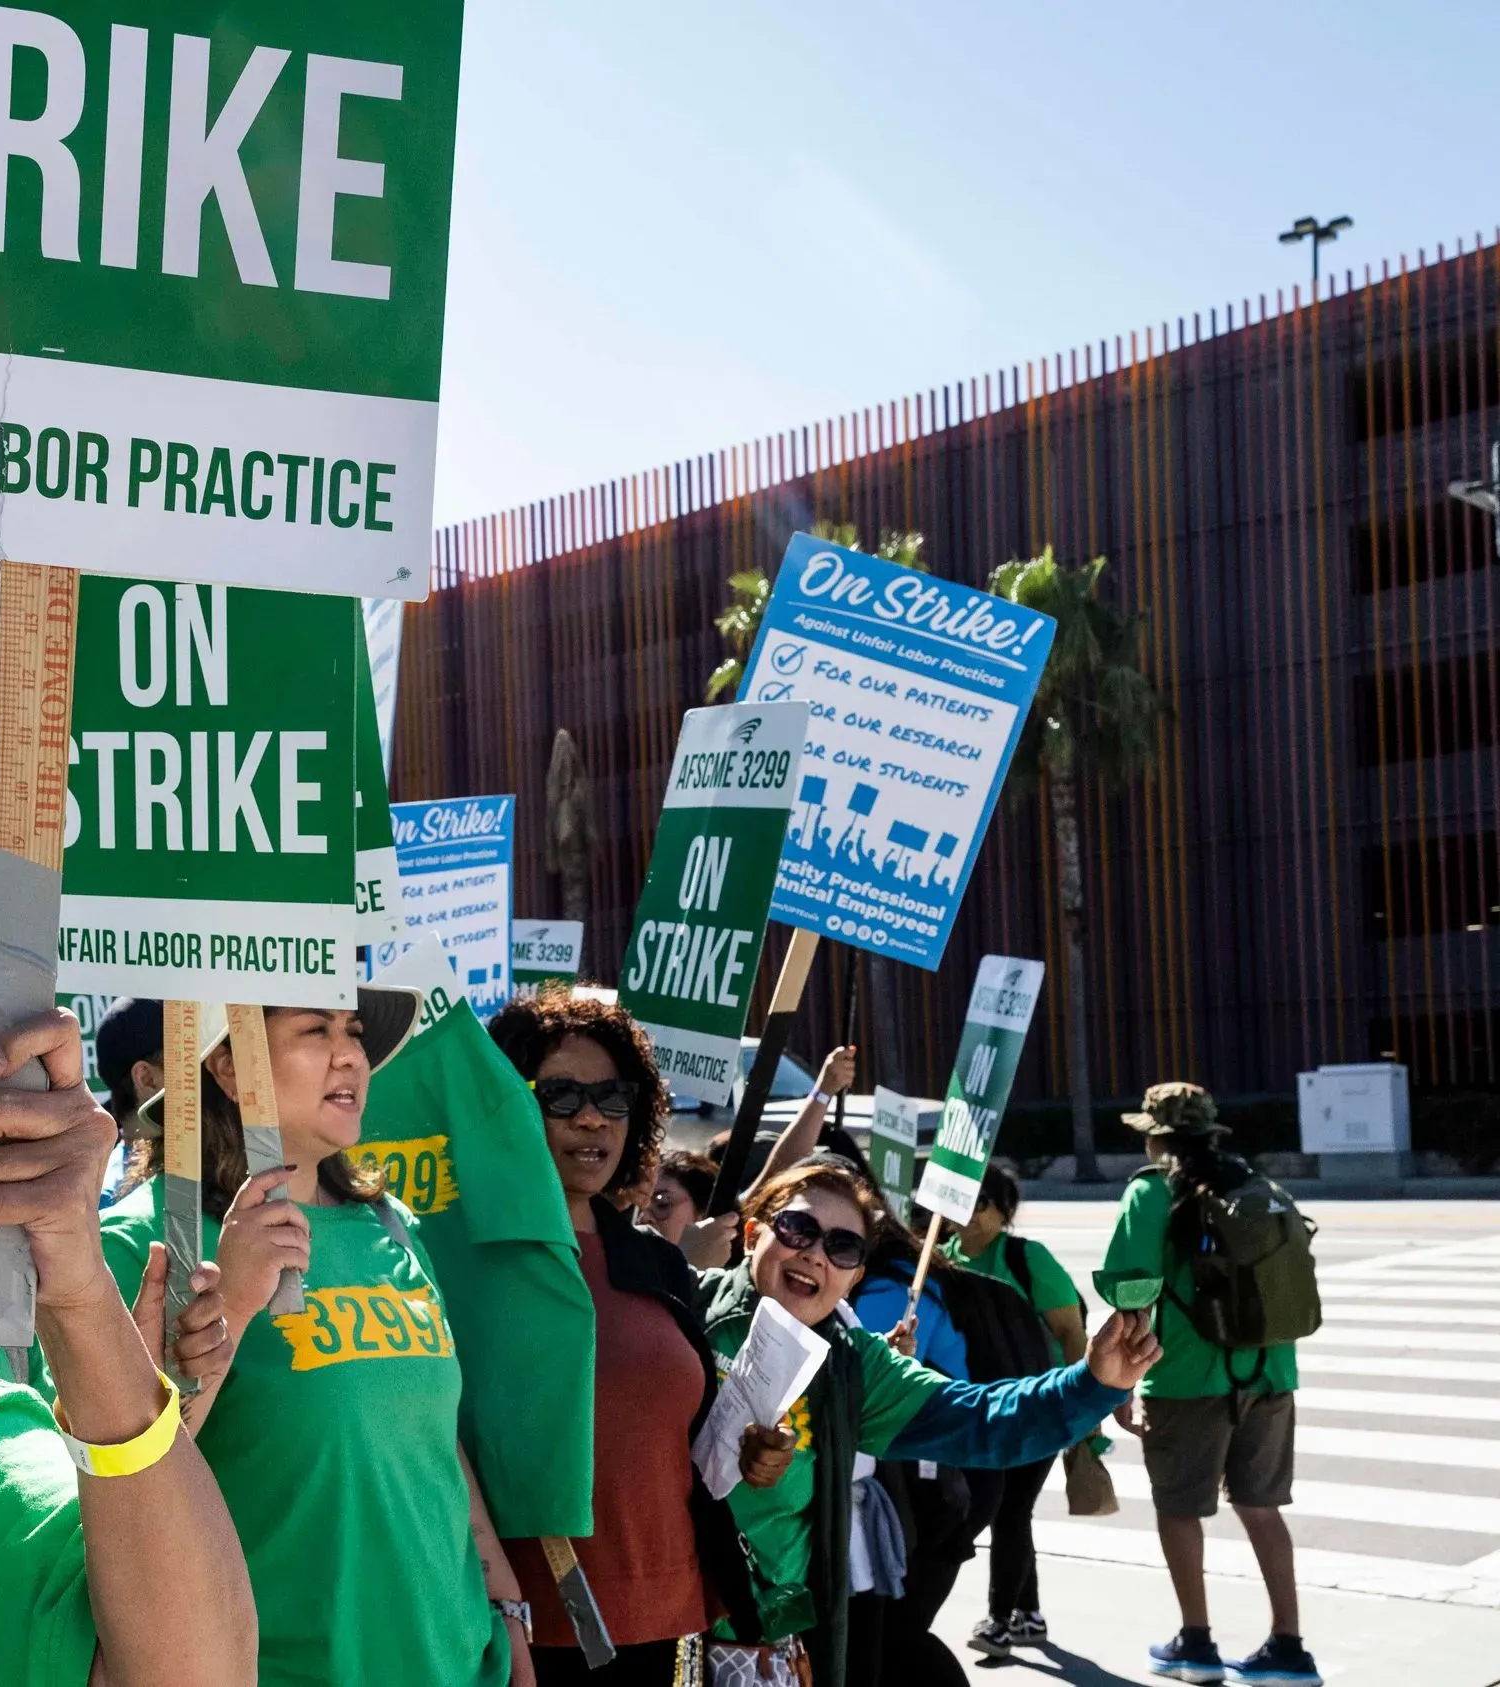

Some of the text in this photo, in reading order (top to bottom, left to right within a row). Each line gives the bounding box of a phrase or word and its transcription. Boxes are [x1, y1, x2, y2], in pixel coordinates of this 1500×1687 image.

[127, 438, 397, 532] PRACTICE
[799, 551, 1045, 655] On Strike!
[118, 583, 228, 708] ON
[794, 612, 1006, 688] Against Unfair Labor Practices
[34, 566, 75, 837] THE HOME DE
[813, 659, 993, 722] FOR OUR PATIENTS
[810, 700, 983, 762] OR OUR RESEARCH
[675, 749, 791, 791] AFSCME 3299
[804, 741, 970, 797] OR OUR STUDENTS
[420, 799, 509, 843] Strike!
[402, 873, 497, 899] FOR OUR PATIENTS
[678, 834, 732, 912] ON
[829, 872, 947, 921] Professional
[427, 911, 448, 923] OUR
[451, 901, 498, 918] RESEARCH
[774, 872, 939, 937] hnical Employees
[58, 926, 336, 975] NFAIR LABOR PRACTICE
[453, 928, 498, 946] STUDENTS
[537, 944, 573, 963] 3299
[627, 919, 753, 1009] STRIKE
[419, 986, 450, 1026] 99
[184, 1034, 196, 1091] HOME
[652, 1043, 729, 1084] BOR PRACTICE
[964, 1044, 998, 1097] ON
[184, 1097, 196, 1135] THE
[937, 1096, 998, 1163] STRIKE
[305, 1295, 442, 1355] 3299
